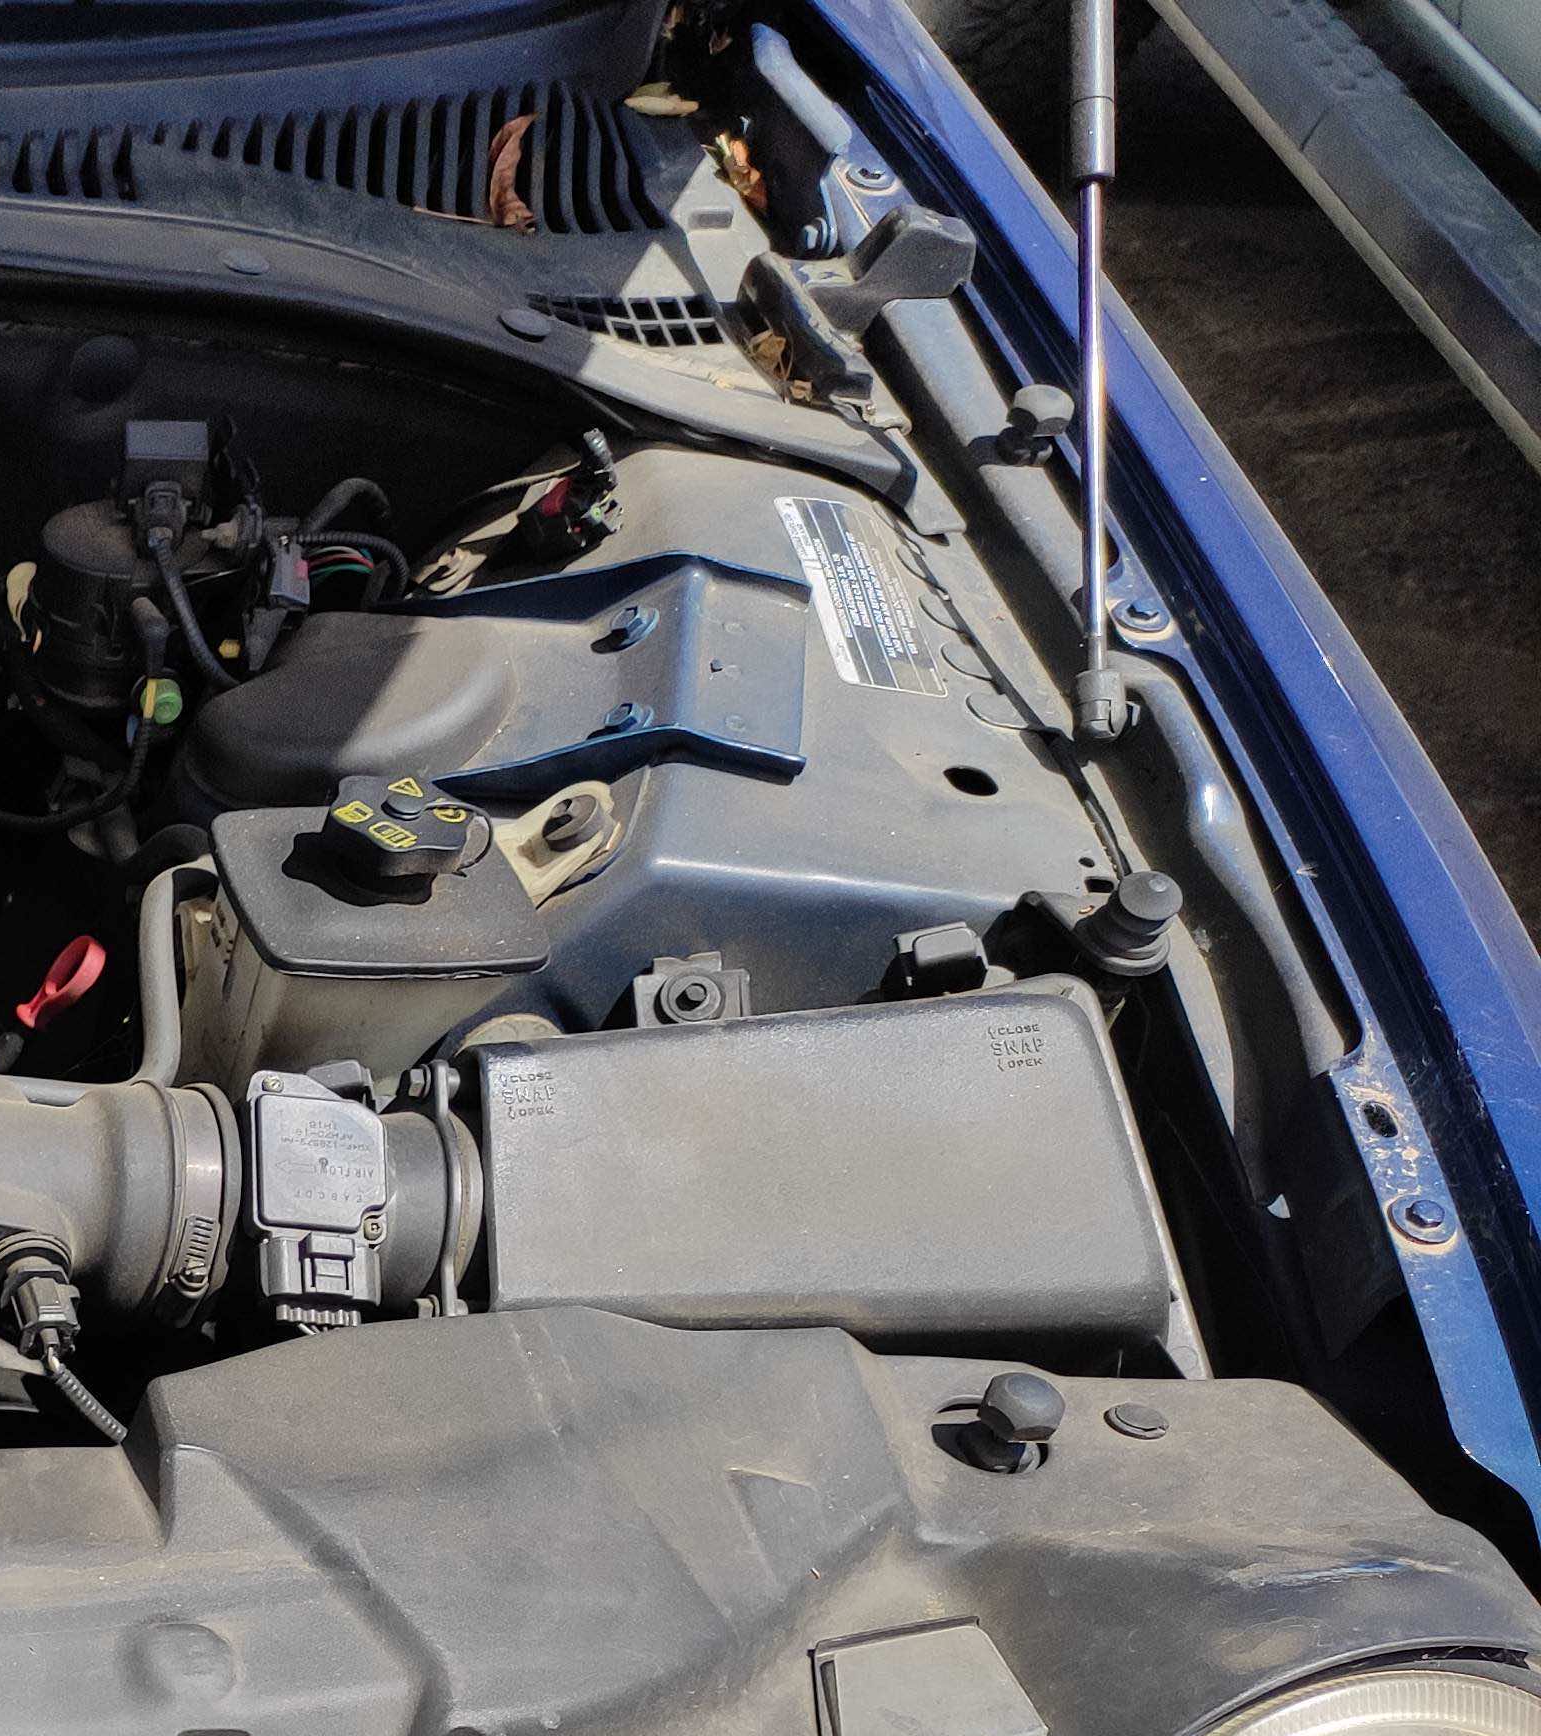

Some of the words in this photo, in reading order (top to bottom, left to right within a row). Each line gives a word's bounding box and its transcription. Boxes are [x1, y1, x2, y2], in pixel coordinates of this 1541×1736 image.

[998, 1024, 1040, 1035] CLOSE
[510, 1071, 554, 1083] CLOSE
[356, 1168, 374, 1179] AIR
